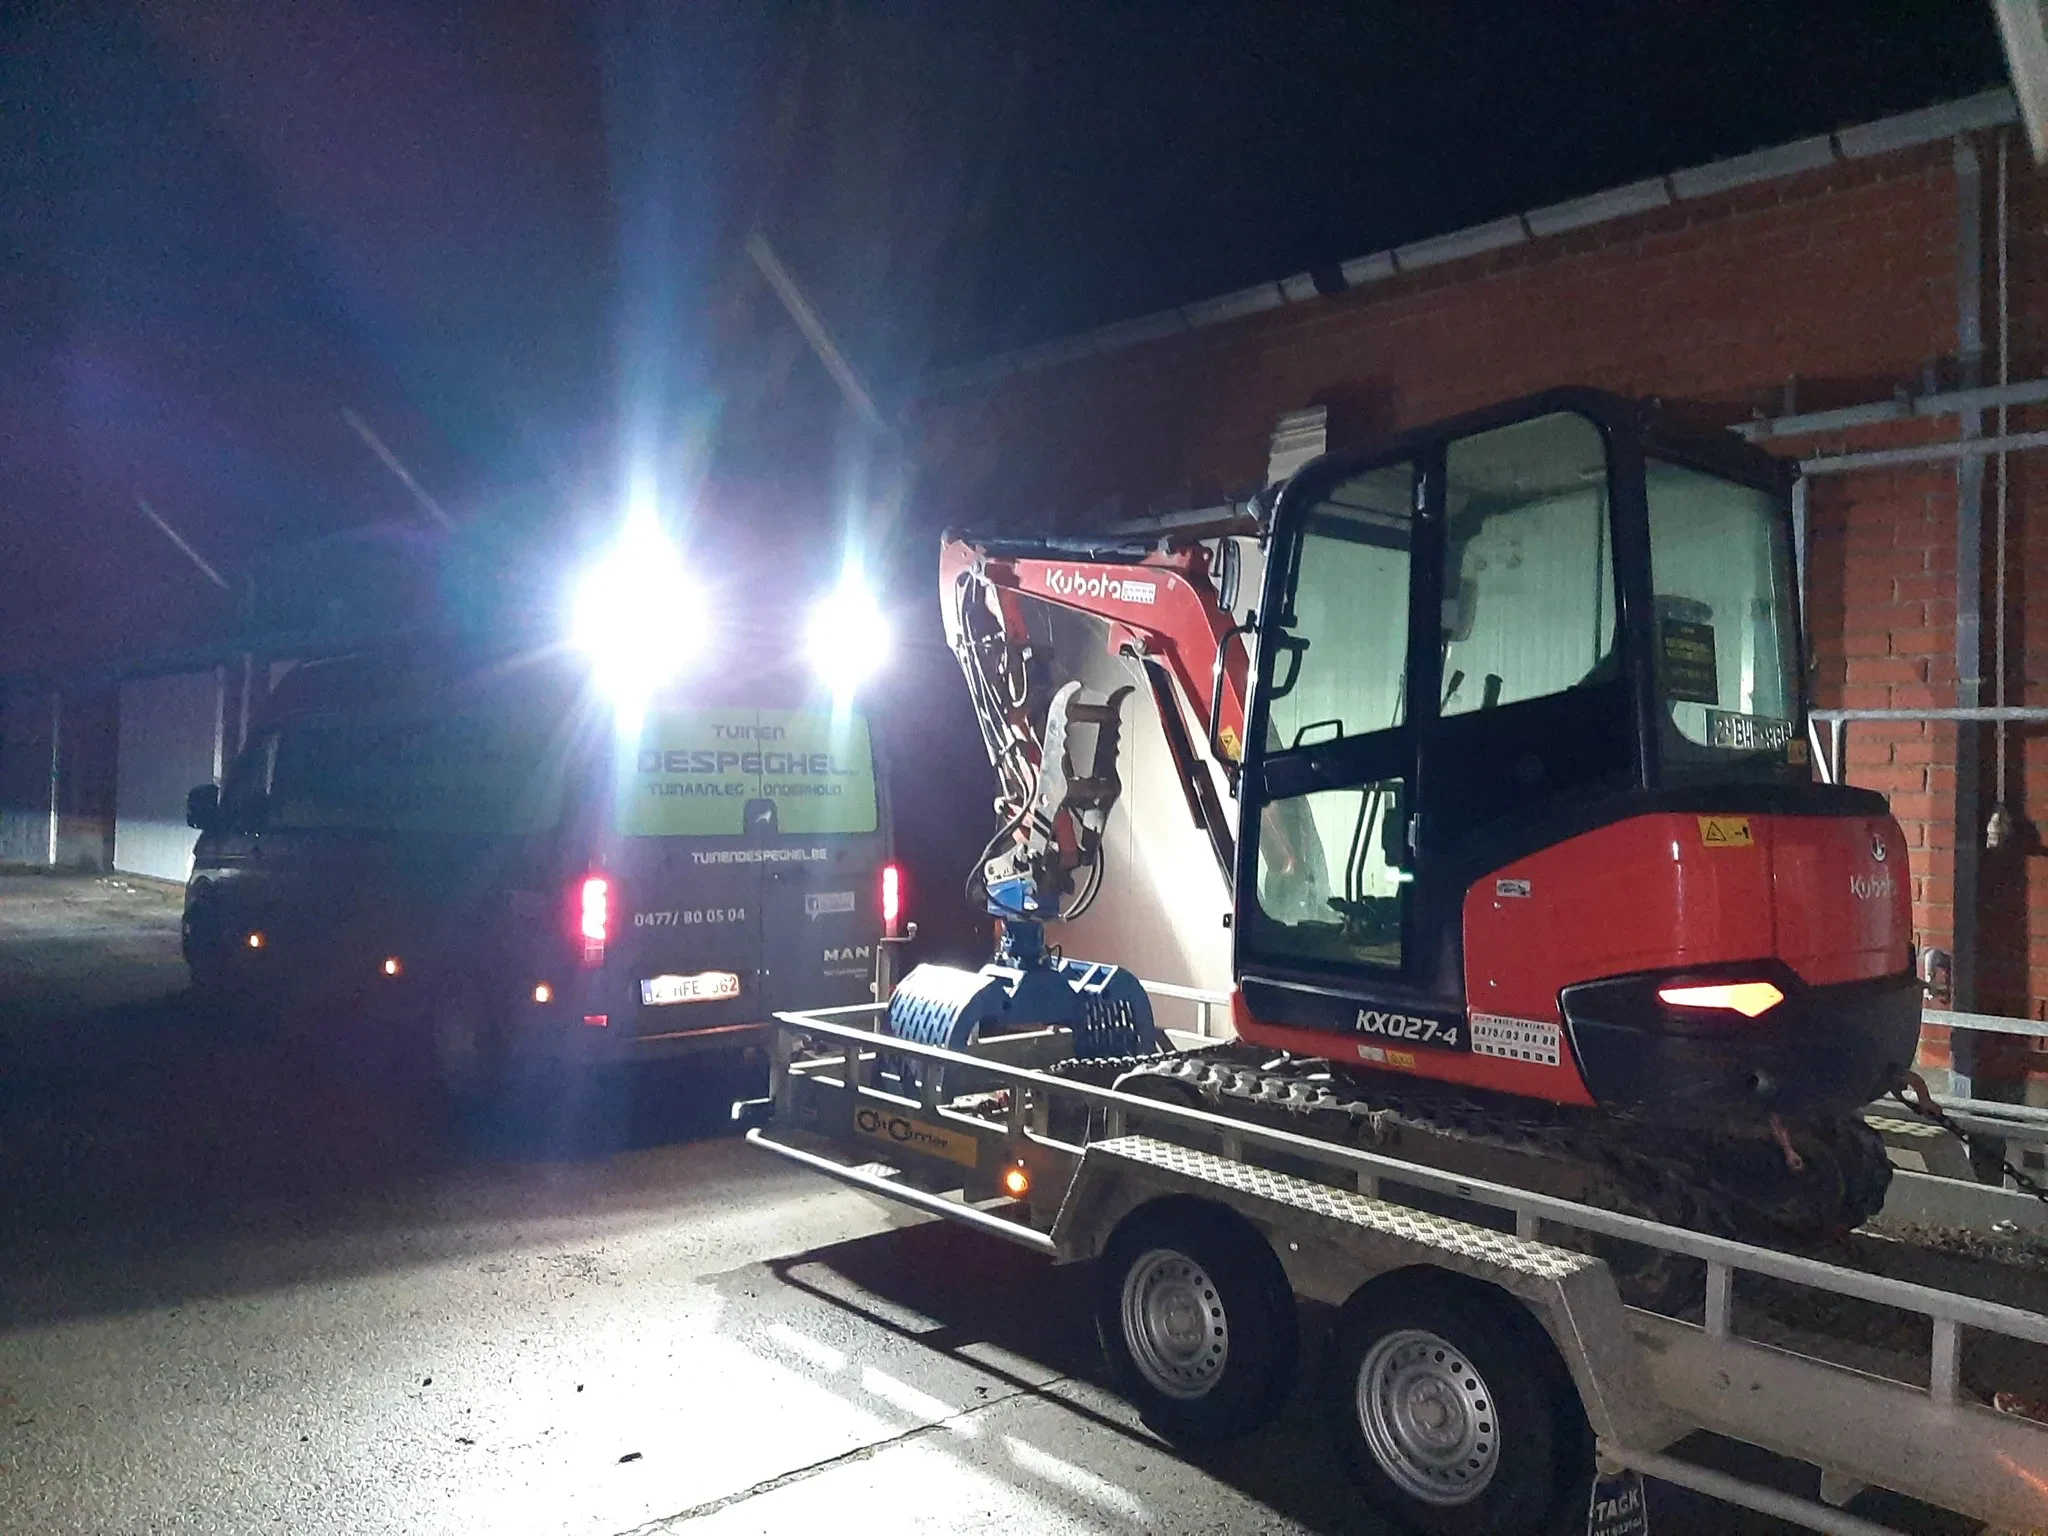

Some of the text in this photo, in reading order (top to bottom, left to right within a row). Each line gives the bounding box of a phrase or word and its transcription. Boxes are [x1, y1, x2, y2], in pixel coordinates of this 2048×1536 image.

[1046, 568, 1122, 601] Kubota
[824, 945, 870, 961] MAN
[1355, 1009, 1458, 1046] KX027-4
